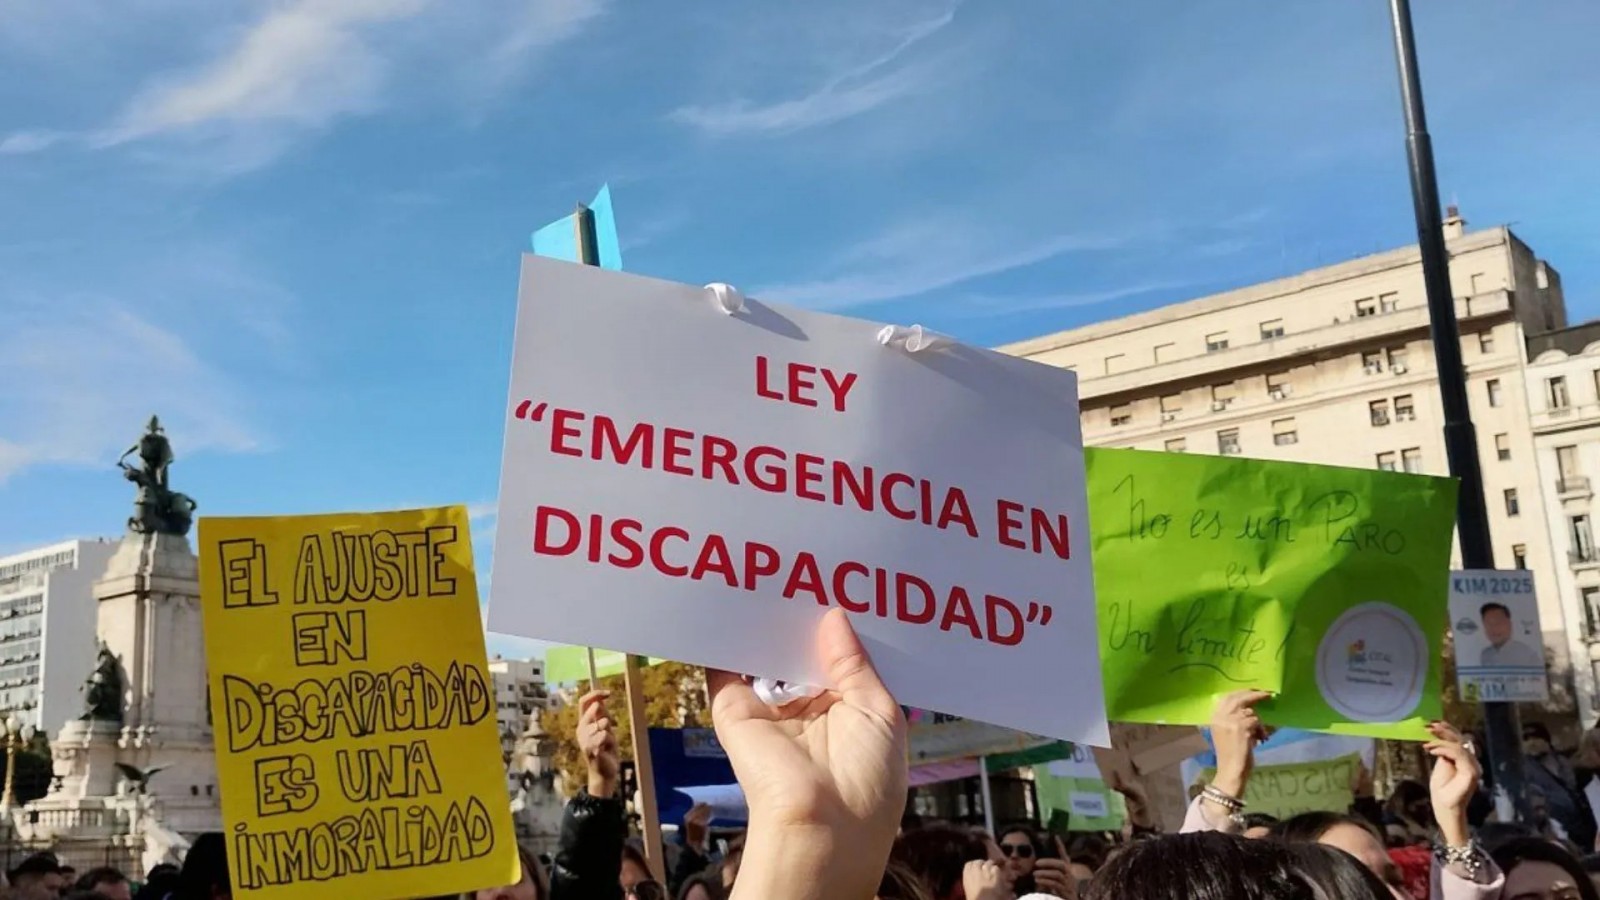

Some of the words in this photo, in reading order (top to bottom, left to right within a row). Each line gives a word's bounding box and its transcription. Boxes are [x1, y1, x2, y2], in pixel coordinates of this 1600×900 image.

[756, 356, 858, 412] LEY
[997, 499, 1071, 560] EN
[1113, 474, 1172, 541] No
[1190, 509, 1222, 540] es
[1235, 514, 1295, 542] un
[218, 537, 279, 609] EL
[294, 525, 457, 604] AJUSTE
[1226, 561, 1250, 591] es
[292, 609, 367, 666] EN
[1109, 599, 1154, 655] Un
[254, 753, 319, 817] ES
[336, 739, 442, 802] UNA
